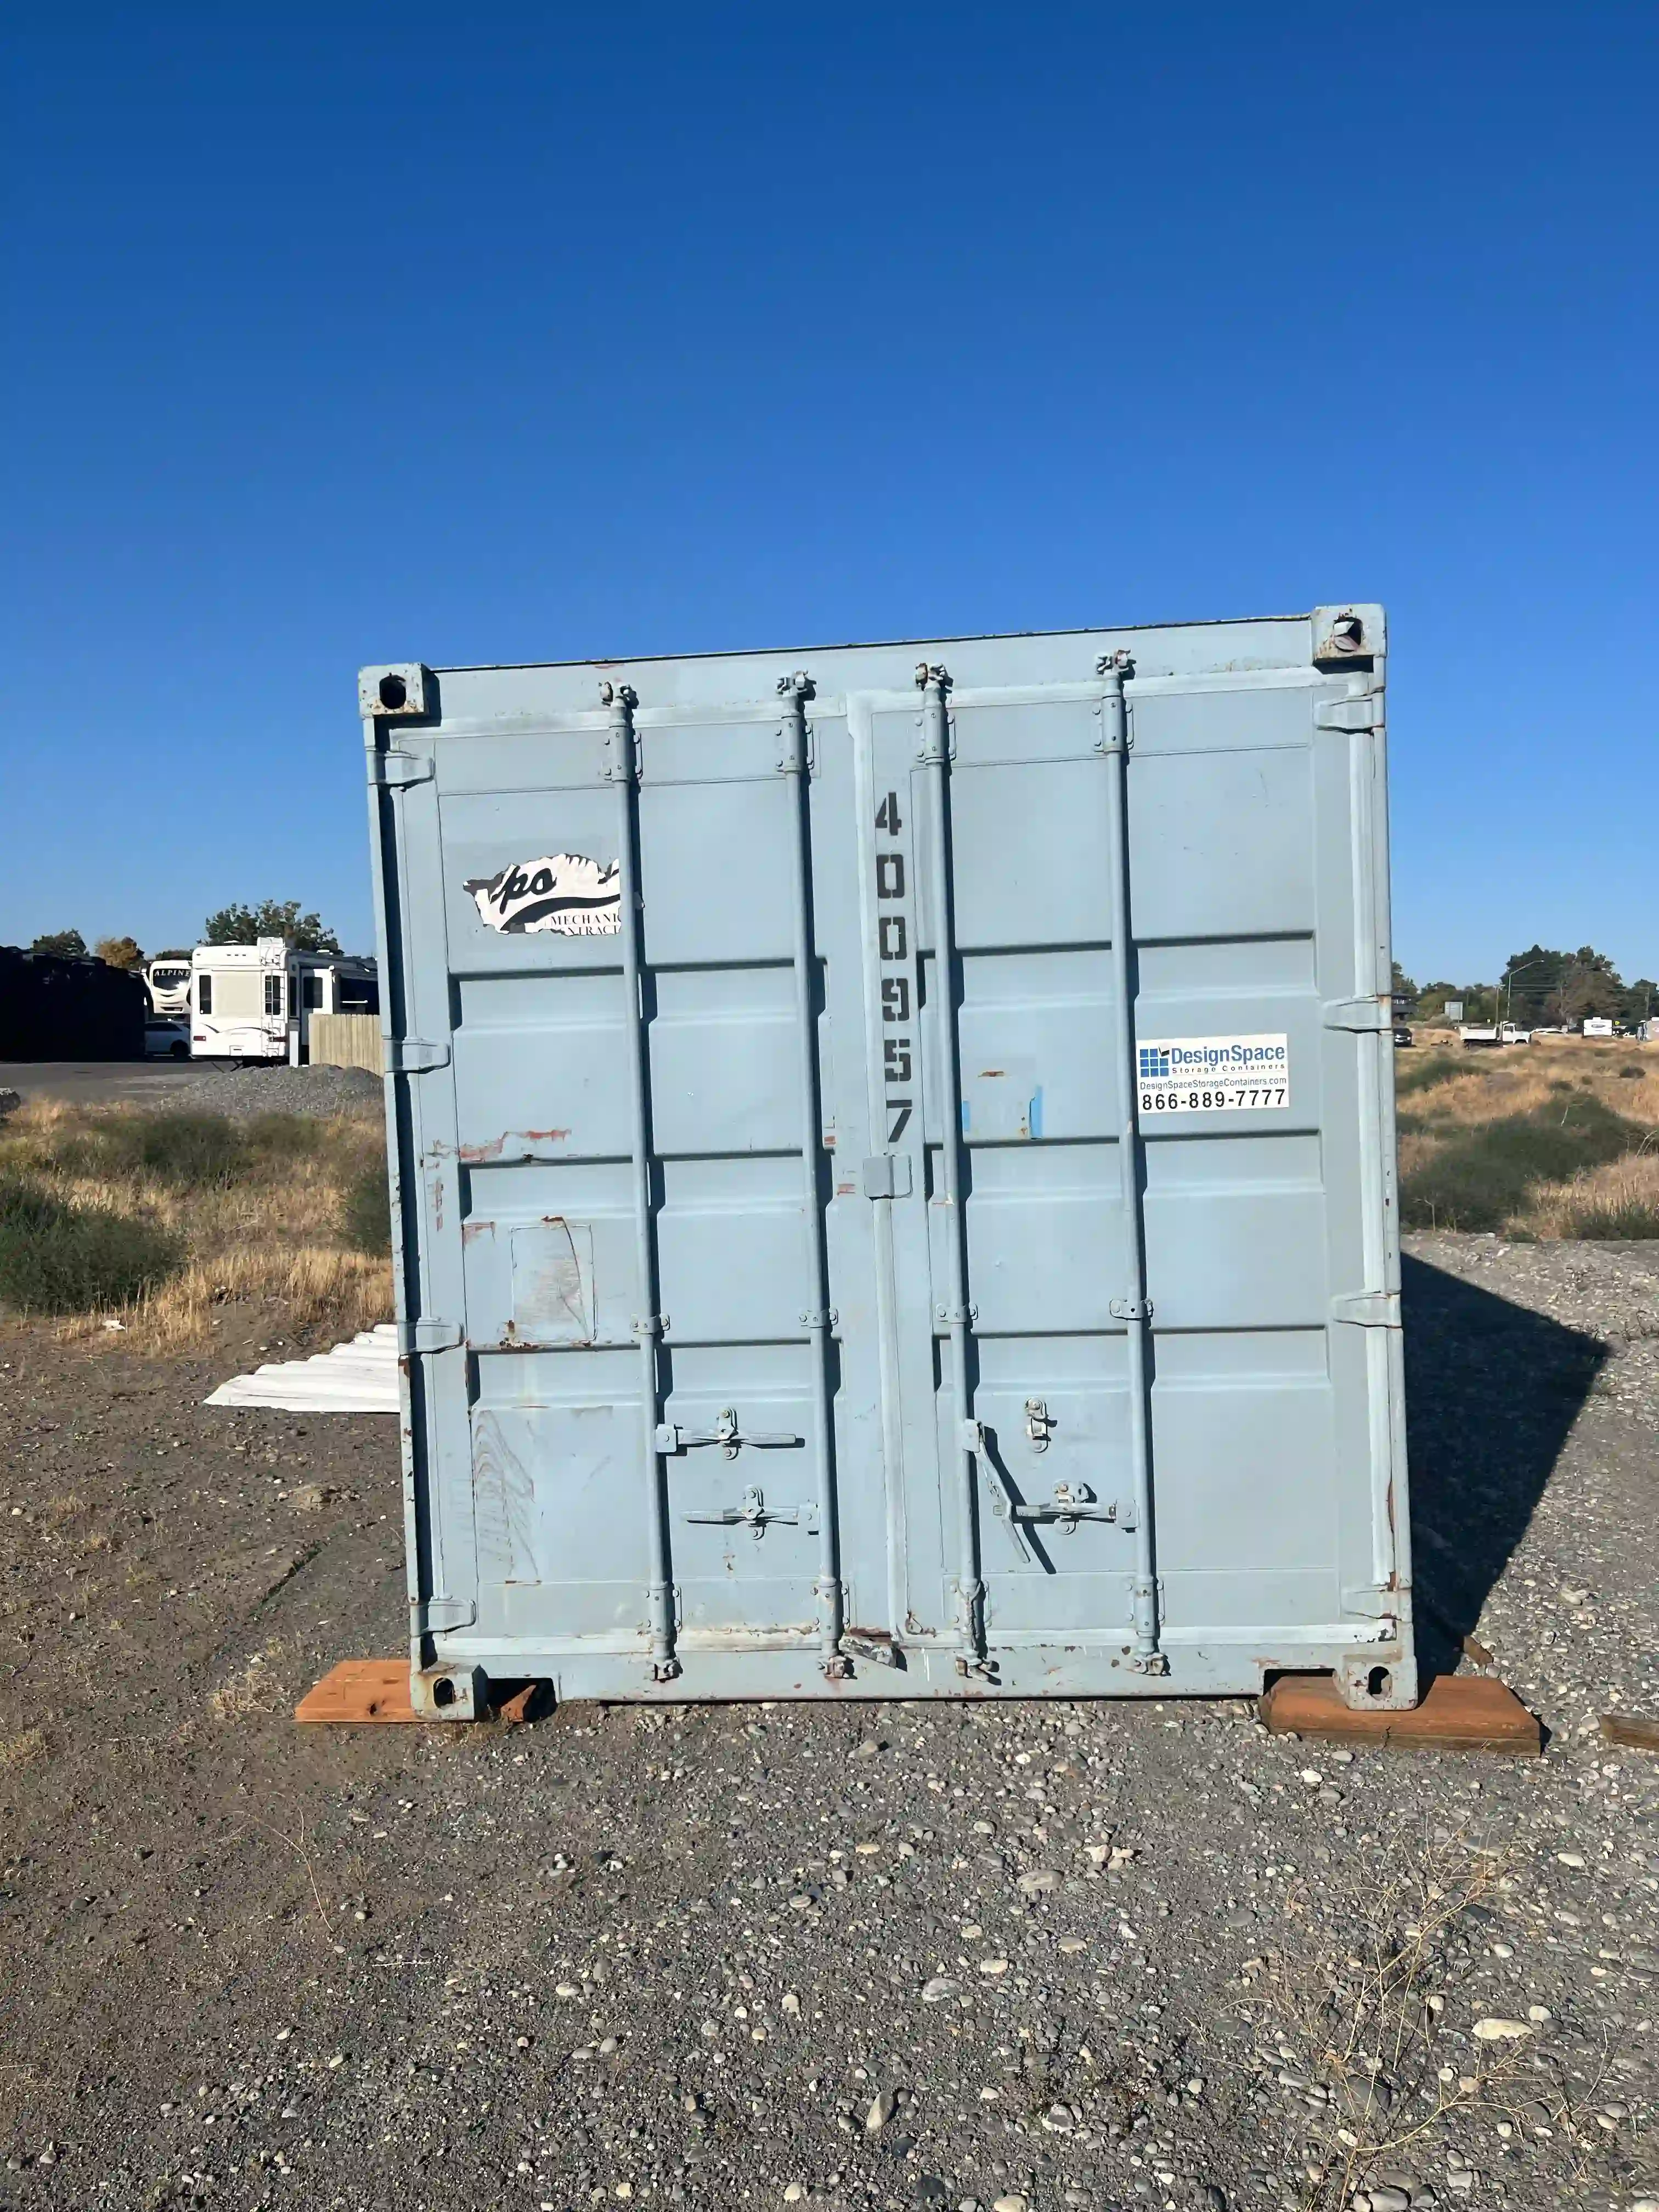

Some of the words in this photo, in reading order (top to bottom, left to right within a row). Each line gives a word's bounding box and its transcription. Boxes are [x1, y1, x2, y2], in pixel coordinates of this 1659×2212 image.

[874, 792, 912, 1142] 400957
[1171, 1045, 1285, 1066] DesignSpace
[1140, 1077, 1286, 1091] DesignSpaceStorageContainers.com
[1142, 1089, 1285, 1110] 866-889-7777
